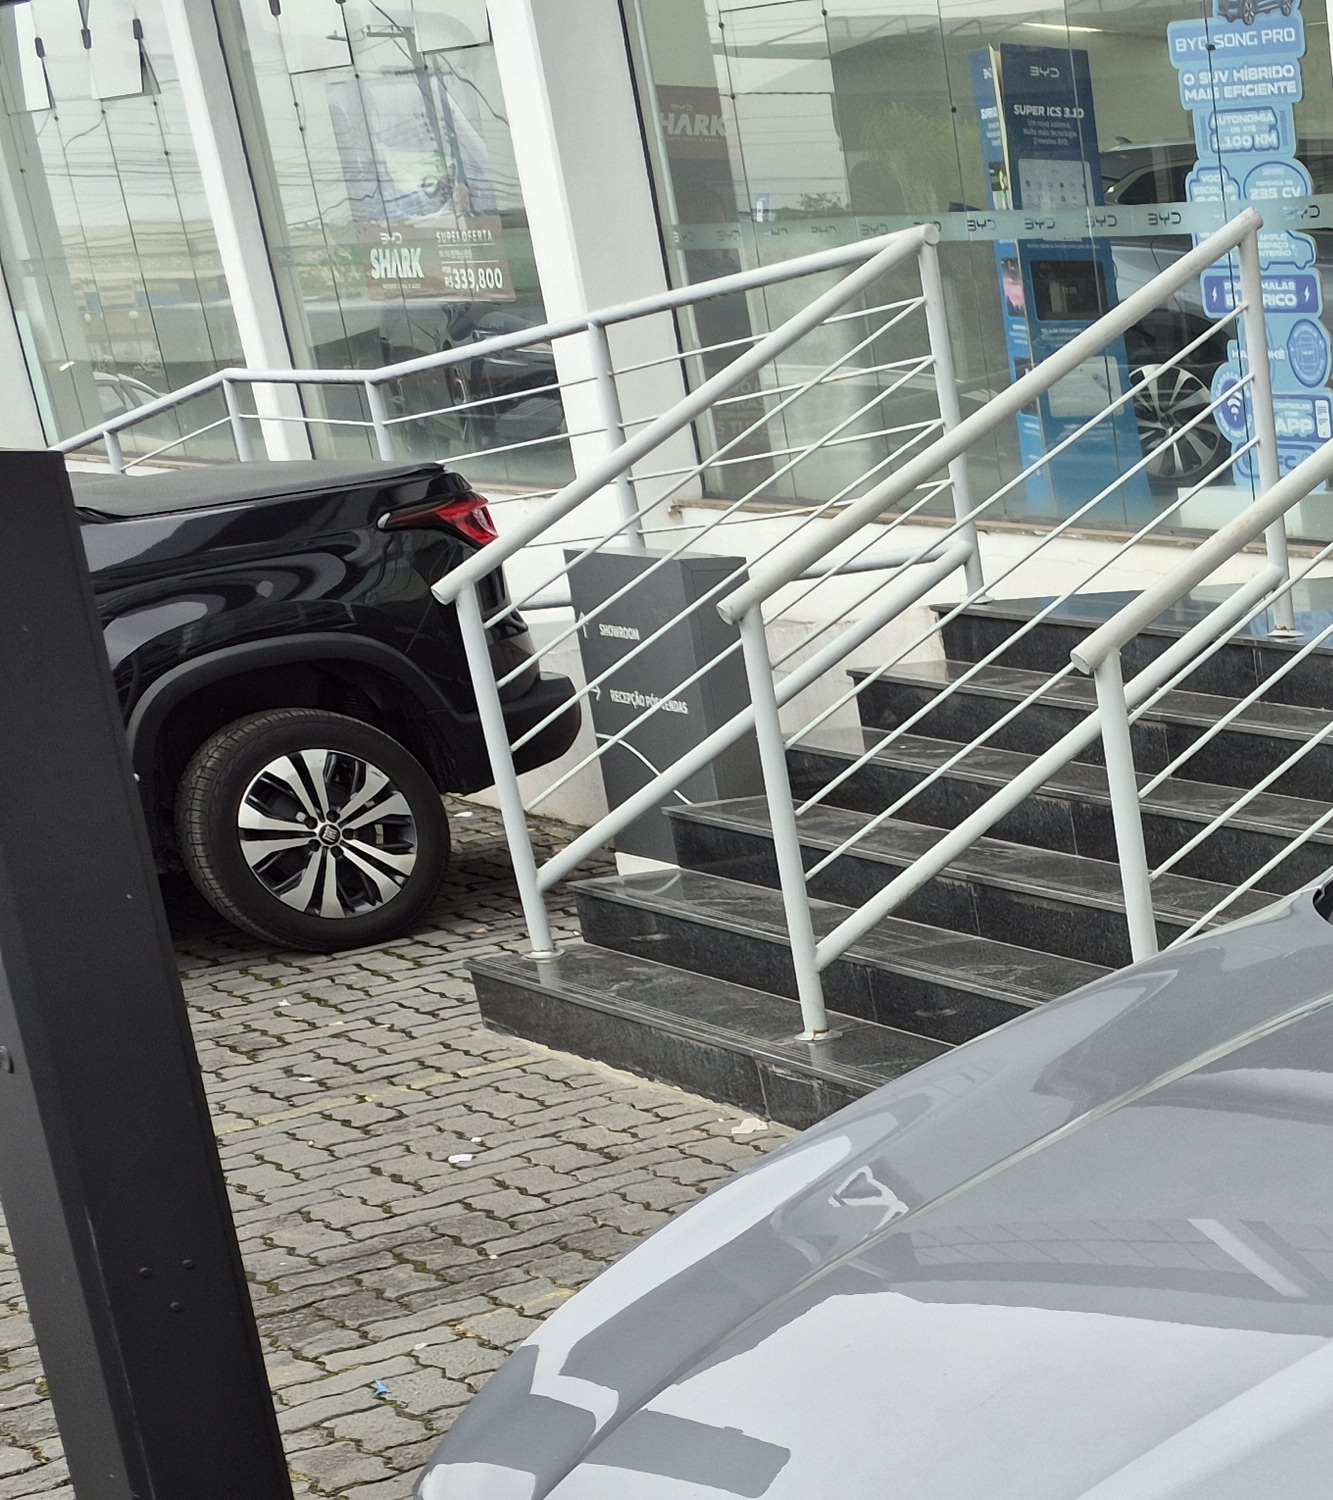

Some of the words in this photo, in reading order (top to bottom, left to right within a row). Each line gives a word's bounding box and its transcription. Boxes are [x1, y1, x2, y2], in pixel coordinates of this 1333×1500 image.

[1175, 36, 1209, 52] BYD
[1213, 31, 1258, 48] SONG
[1261, 27, 1296, 44] PRO
[1029, 65, 1060, 78] BYD
[1183, 73, 1195, 86] O
[1198, 69, 1230, 85] SUV
[1232, 64, 1295, 83] HÍBRIDO
[1184, 87, 1220, 101] MAIS
[1223, 80, 1297, 98] EFICIENTE
[1013, 104, 1045, 116] SUPER
[1047, 107, 1062, 117] ICS
[1064, 107, 1085, 118] 3.10
[659, 112, 727, 137] HARK
[1212, 112, 1275, 126] AUTONOMIA
[1255, 132, 1278, 146] KM
[1249, 187, 1278, 200] 235
[1281, 186, 1301, 198] CV
[966, 218, 996, 232] BYD
[1024, 217, 1056, 230] BYD
[1085, 214, 1118, 228] BYD
[1148, 212, 1182, 226] BYD
[462, 229, 494, 242] OFERTA
[860, 223, 889, 236] BYD
[1259, 248, 1292, 258] NTERNO
[370, 247, 425, 279] SHARK
[1225, 293, 1298, 308] ELRICO
[1275, 418, 1314, 434] APP
[1279, 454, 1297, 470] FC
[599, 623, 640, 641] SHOWROOM
[610, 689, 646, 710] RECEPÇÃO
[645, 692, 689, 715] PÓSVENDAS
